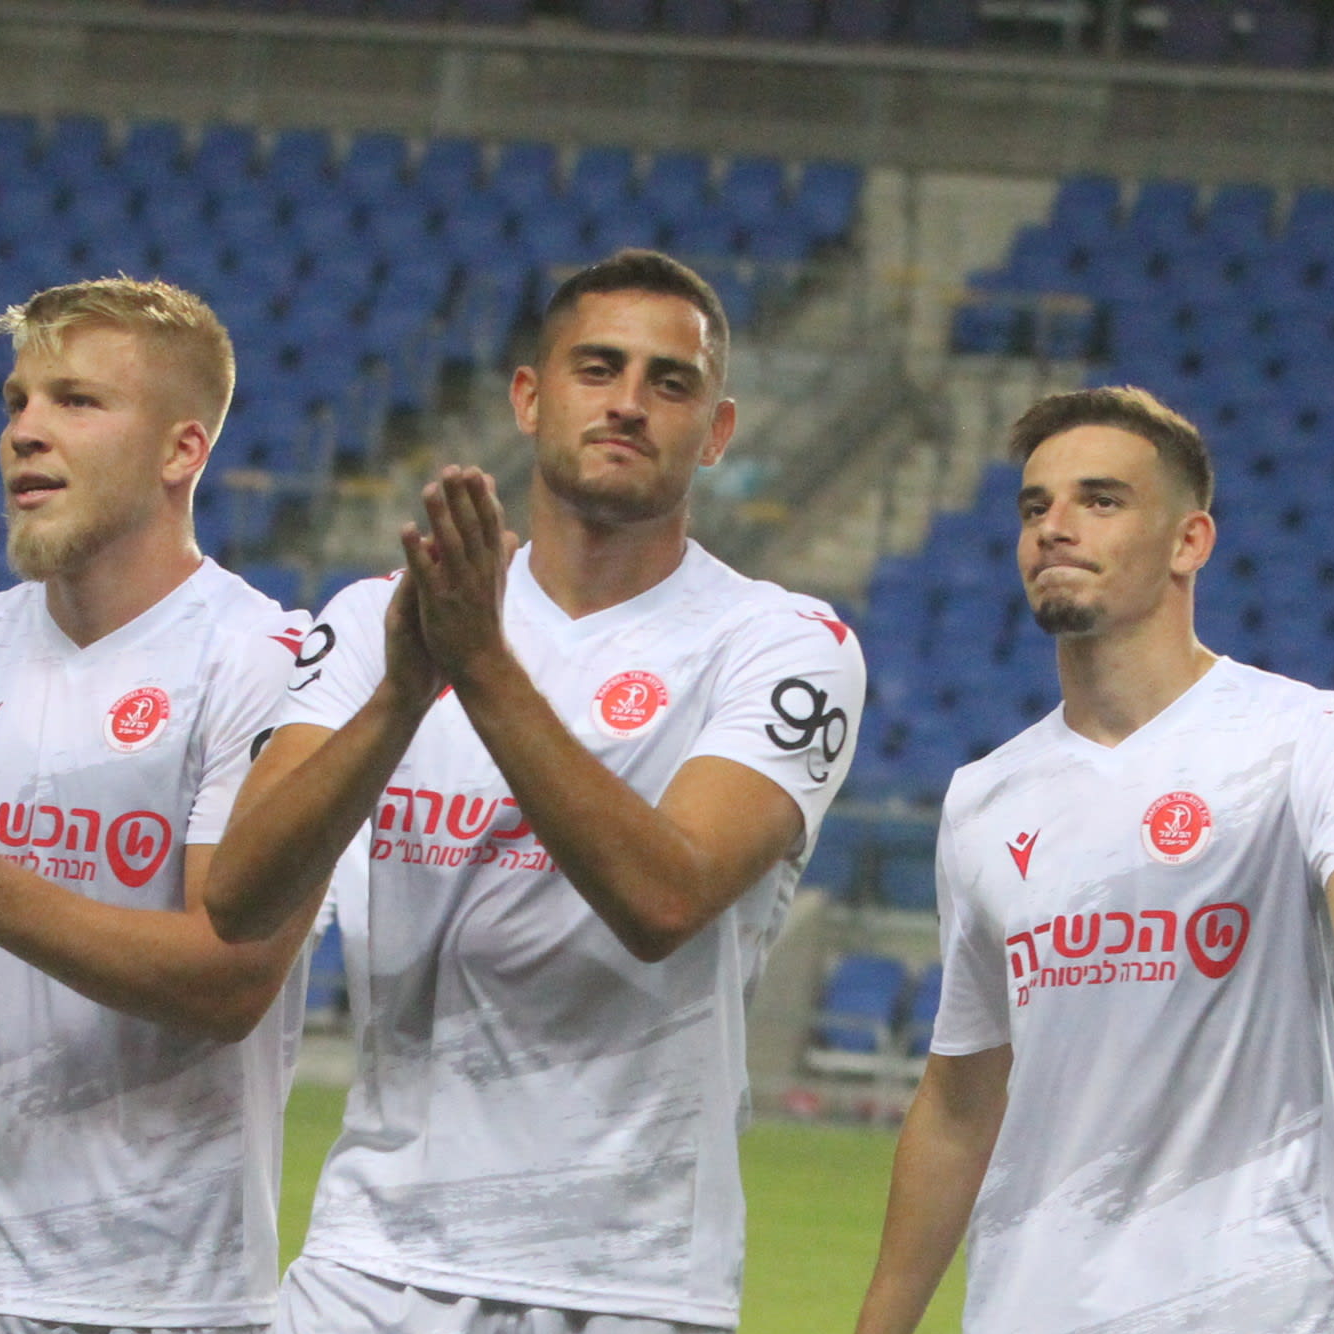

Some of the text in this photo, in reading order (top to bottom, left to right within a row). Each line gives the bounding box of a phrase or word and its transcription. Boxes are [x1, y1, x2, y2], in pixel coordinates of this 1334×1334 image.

[765, 679, 846, 762] go
[378, 787, 543, 845] כשרה
[1040, 960, 1117, 988] לביטוח
